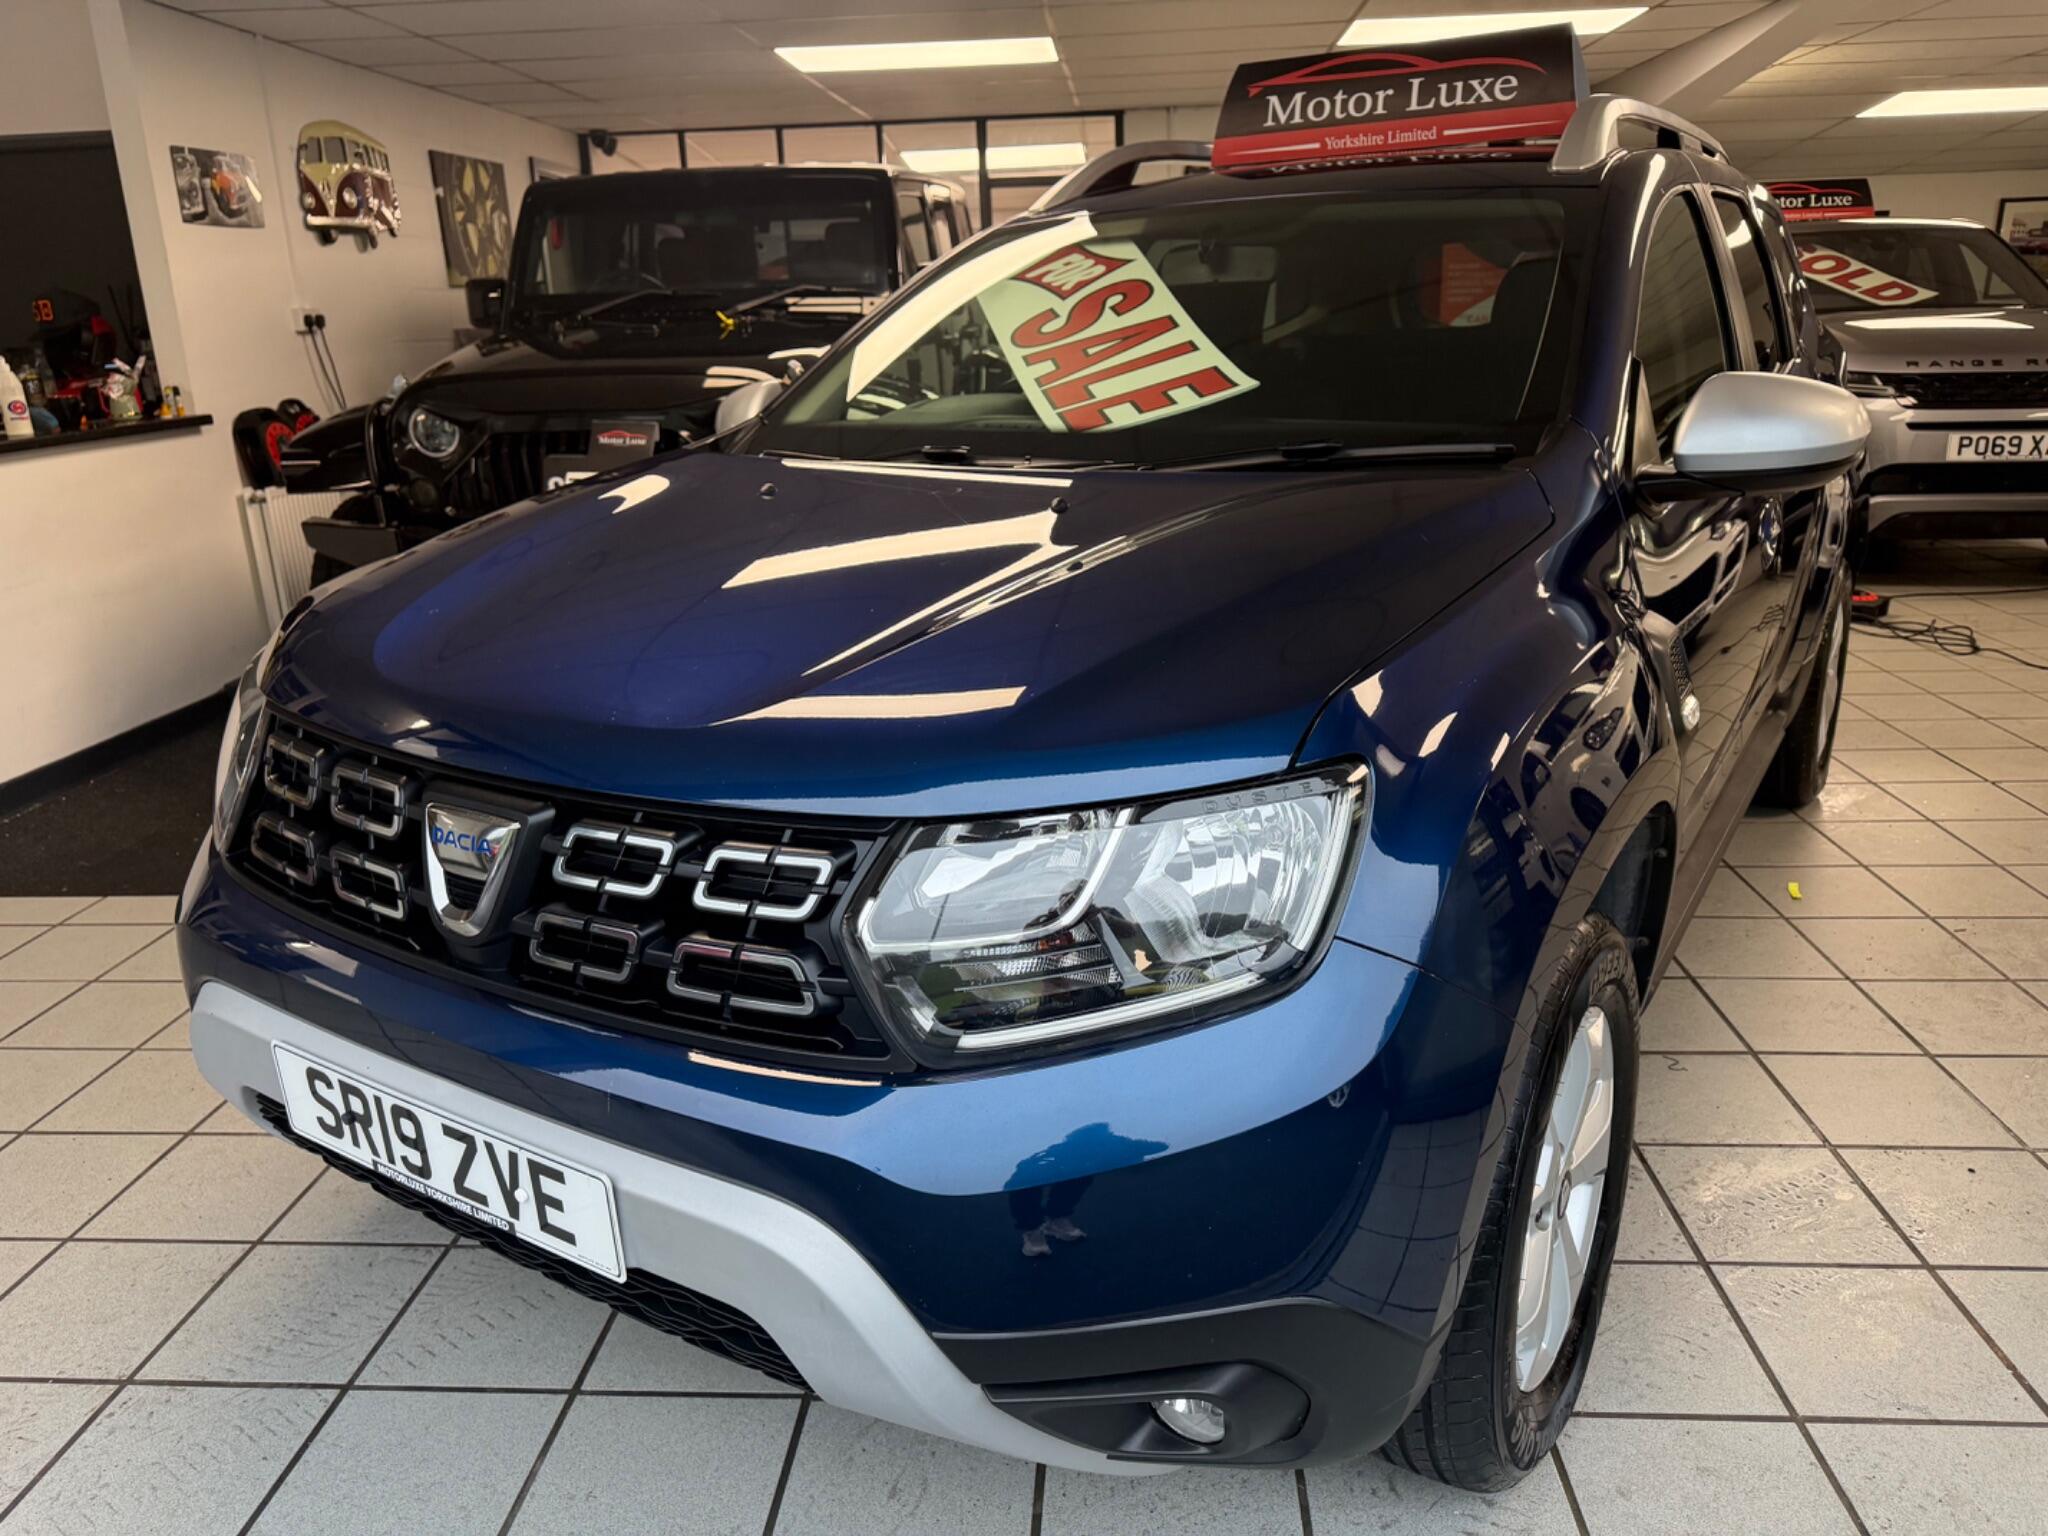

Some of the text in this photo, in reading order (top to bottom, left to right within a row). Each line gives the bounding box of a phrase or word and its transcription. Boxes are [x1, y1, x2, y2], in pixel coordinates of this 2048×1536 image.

[1263, 73, 1519, 128] Motor Luxe
[1325, 126, 1437, 150] Yorkshire Limited
[1775, 193, 1853, 209] tor Luxe
[1025, 251, 1106, 292] FOR
[1010, 278, 1240, 433] SALE
[1906, 358, 2005, 369] RANGE
[2029, 435, 2048, 459] X
[1203, 778, 1337, 813] DUSTER
[431, 825, 493, 857] DACIA
[306, 1065, 577, 1247] SR19 ZVE
[426, 1187, 473, 1216] YORKSHIRE
[472, 1207, 511, 1232] LIMITED
